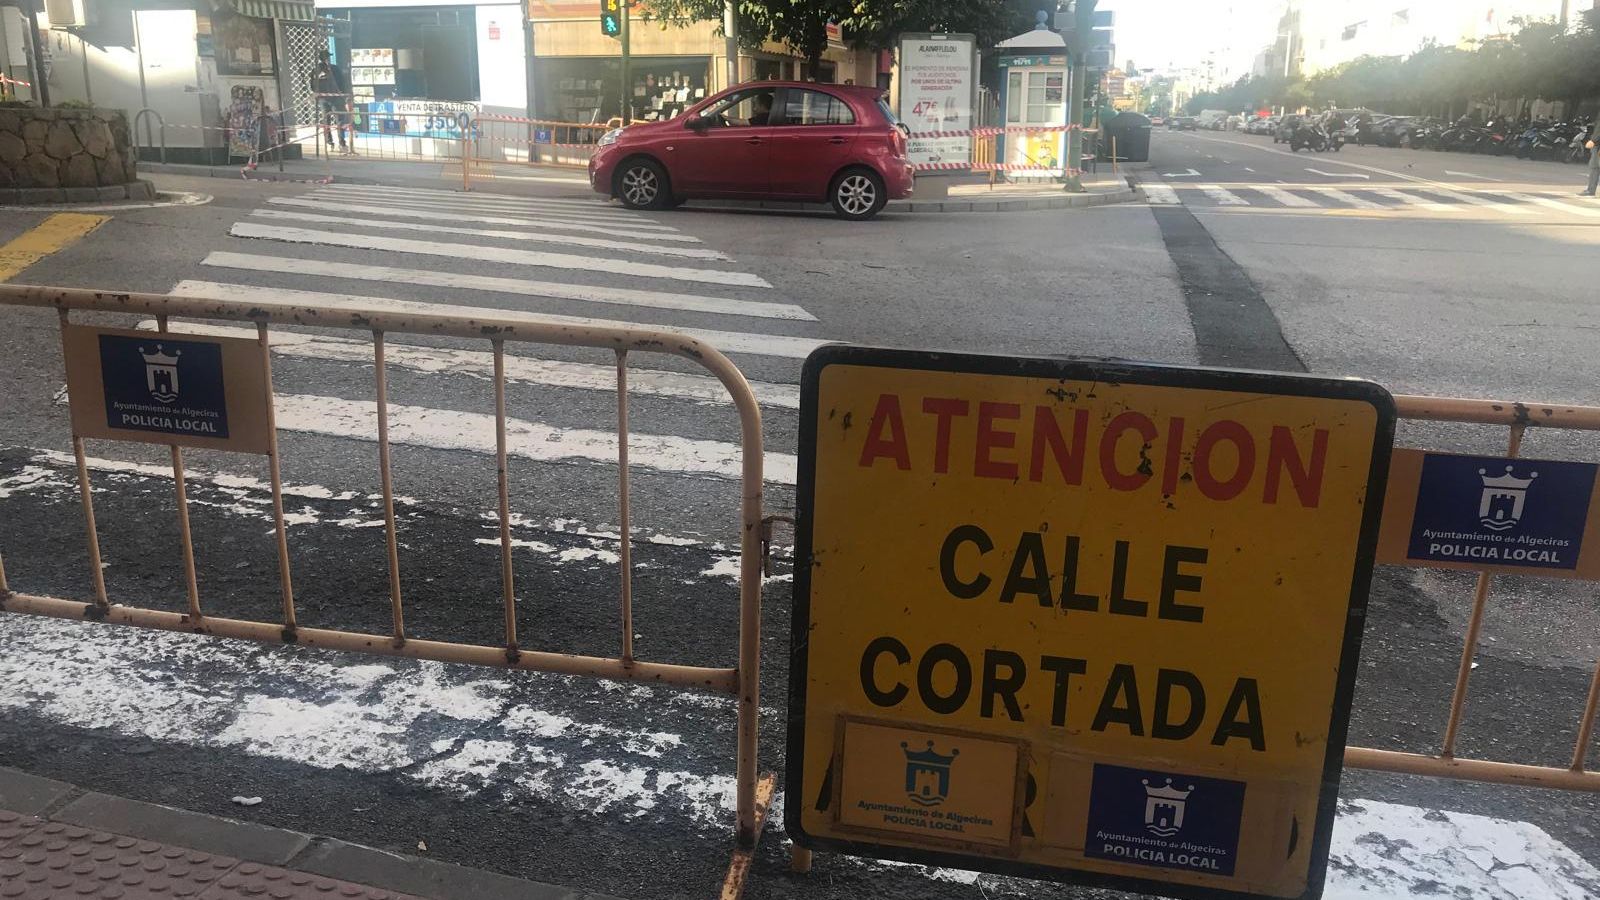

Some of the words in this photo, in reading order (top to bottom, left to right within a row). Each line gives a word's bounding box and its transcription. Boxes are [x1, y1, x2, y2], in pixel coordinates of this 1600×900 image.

[396, 103, 422, 112] VENTA
[423, 103, 433, 112] DE
[912, 101, 938, 117] 47€
[113, 401, 171, 412] Ayuntamiento
[182, 407, 219, 418] Algeciras
[122, 414, 173, 428] POLICIA
[175, 419, 217, 432] LOCAL
[860, 394, 1330, 508] ATENCION
[1423, 529, 1502, 542] Ayuntamiento
[1517, 535, 1569, 547] Algeciras
[1429, 543, 1499, 558] POLICIA
[1503, 548, 1560, 563] LOCAL
[940, 524, 1209, 623] CALLE
[861, 636, 1266, 751] CORTADA
[857, 800, 929, 816] Ayuntamiento
[931, 809, 943, 818] de
[946, 811, 993, 826] Algeciras
[883, 814, 928, 828] POLICIA
[930, 820, 966, 833] LOCAL
[1096, 830, 1168, 847] Ayuntamiento
[1180, 841, 1227, 855] Algeciras
[1103, 843, 1165, 863] POLICIA
[1169, 852, 1220, 870] LOCAL
